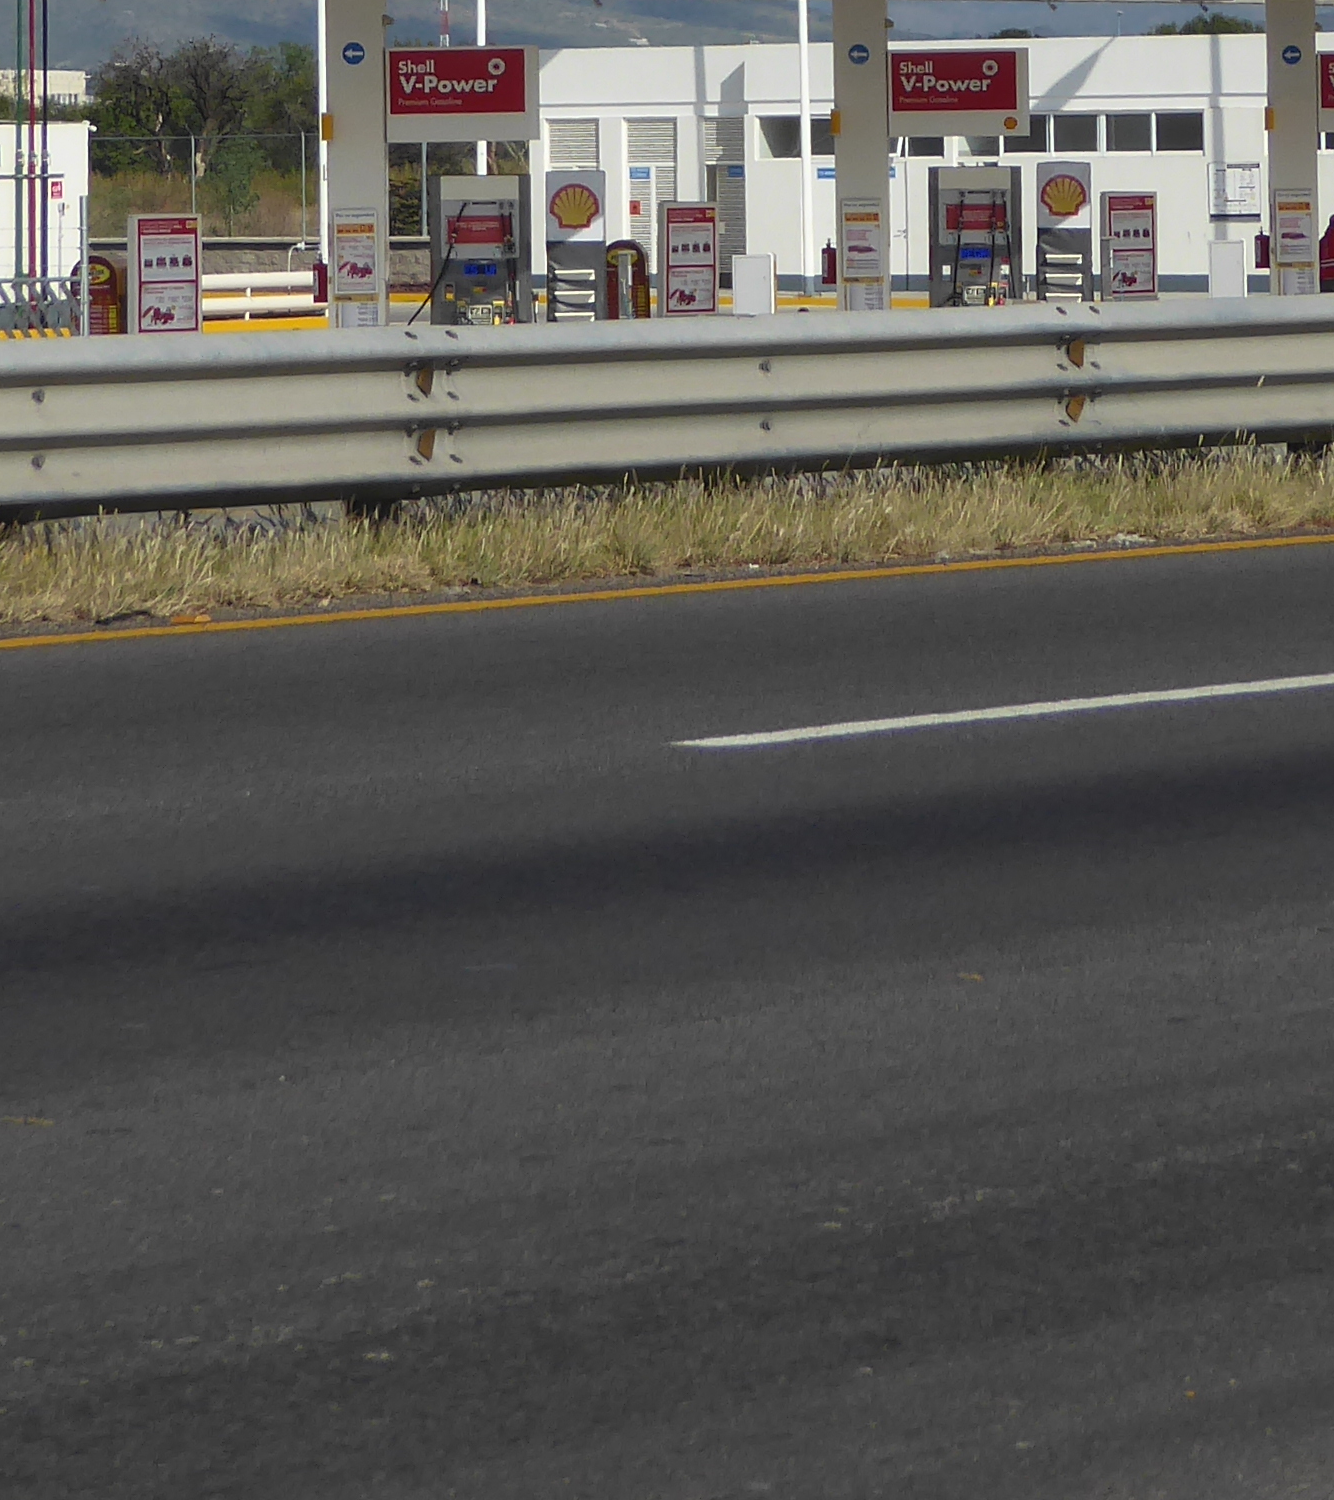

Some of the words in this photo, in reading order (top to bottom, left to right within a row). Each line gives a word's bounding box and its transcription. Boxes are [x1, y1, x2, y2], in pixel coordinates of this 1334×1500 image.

[398, 58, 435, 74] Shell
[899, 60, 933, 74] Shell
[399, 74, 498, 94] V-Power
[900, 74, 992, 93] V-Power
